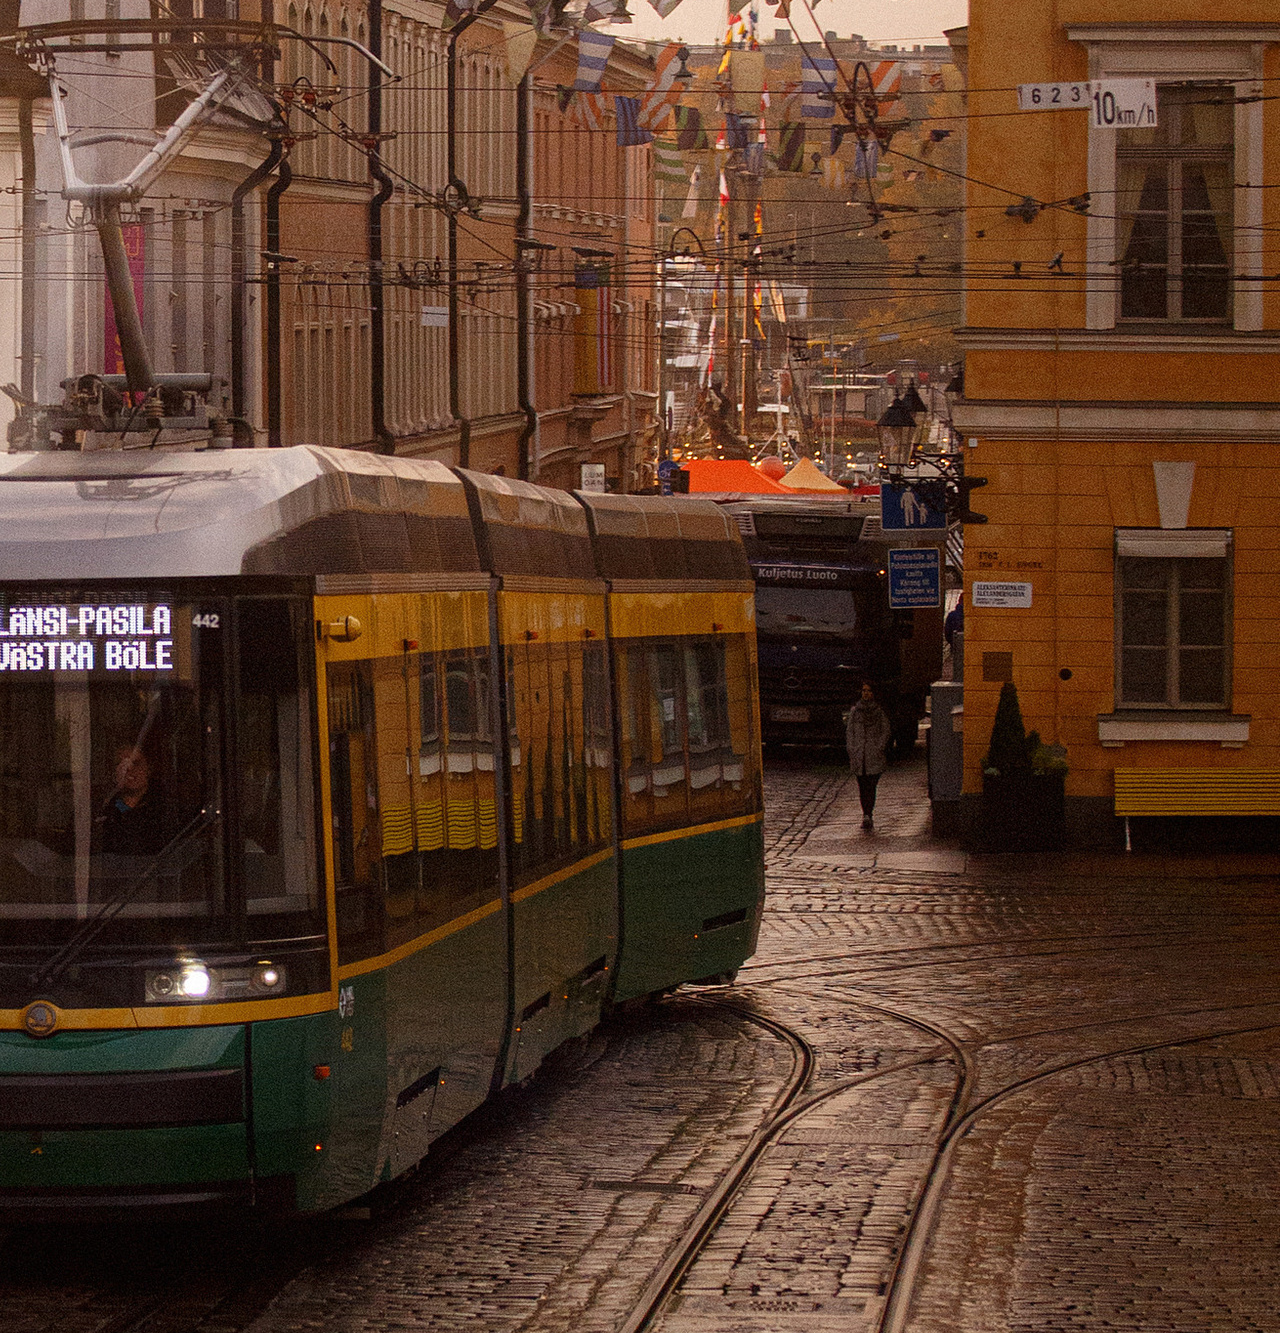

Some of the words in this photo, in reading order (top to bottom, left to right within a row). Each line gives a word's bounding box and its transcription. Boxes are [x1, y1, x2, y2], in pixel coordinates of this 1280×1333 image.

[758, 567, 803, 580] Kuljetus
[806, 570, 838, 580] Luoto
[191, 613, 220, 629] 442
